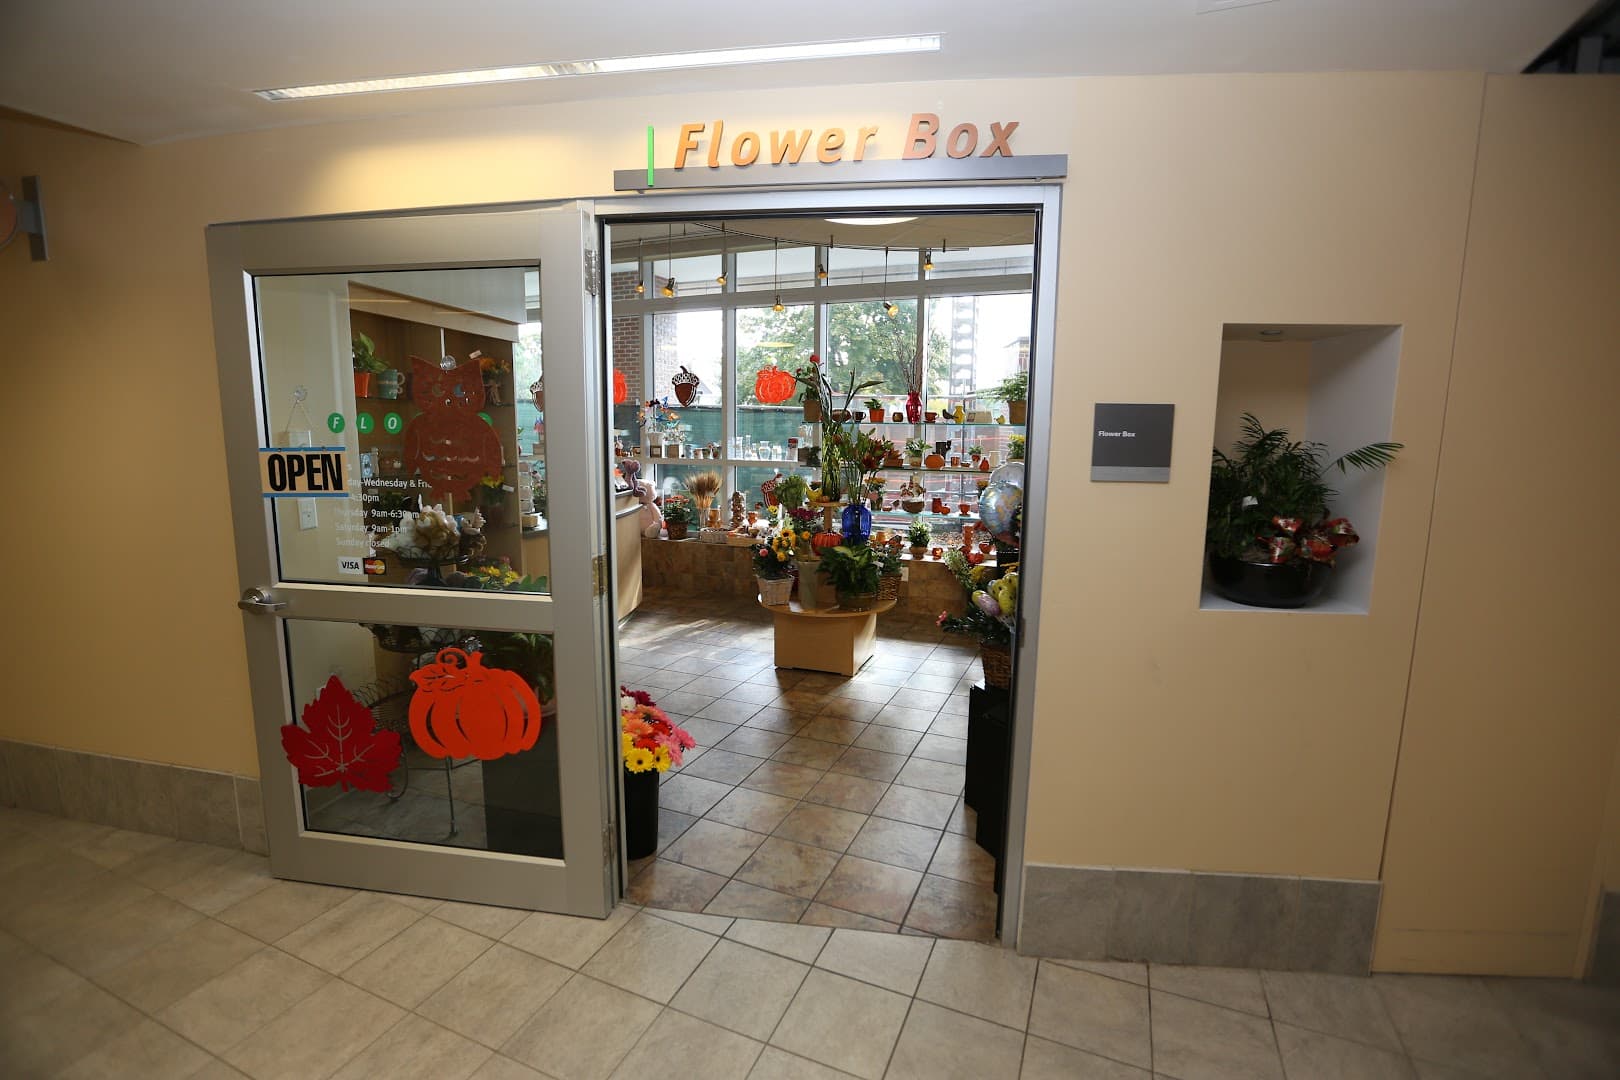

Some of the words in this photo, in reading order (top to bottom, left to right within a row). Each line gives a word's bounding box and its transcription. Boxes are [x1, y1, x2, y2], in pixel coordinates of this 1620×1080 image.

[674, 119, 880, 170] Flower
[901, 112, 1020, 161] Box
[1122, 430, 1136, 438] Box
[267, 453, 344, 492] OPEN
[409, 479, 417, 488] &
[341, 561, 360, 570] VISA
